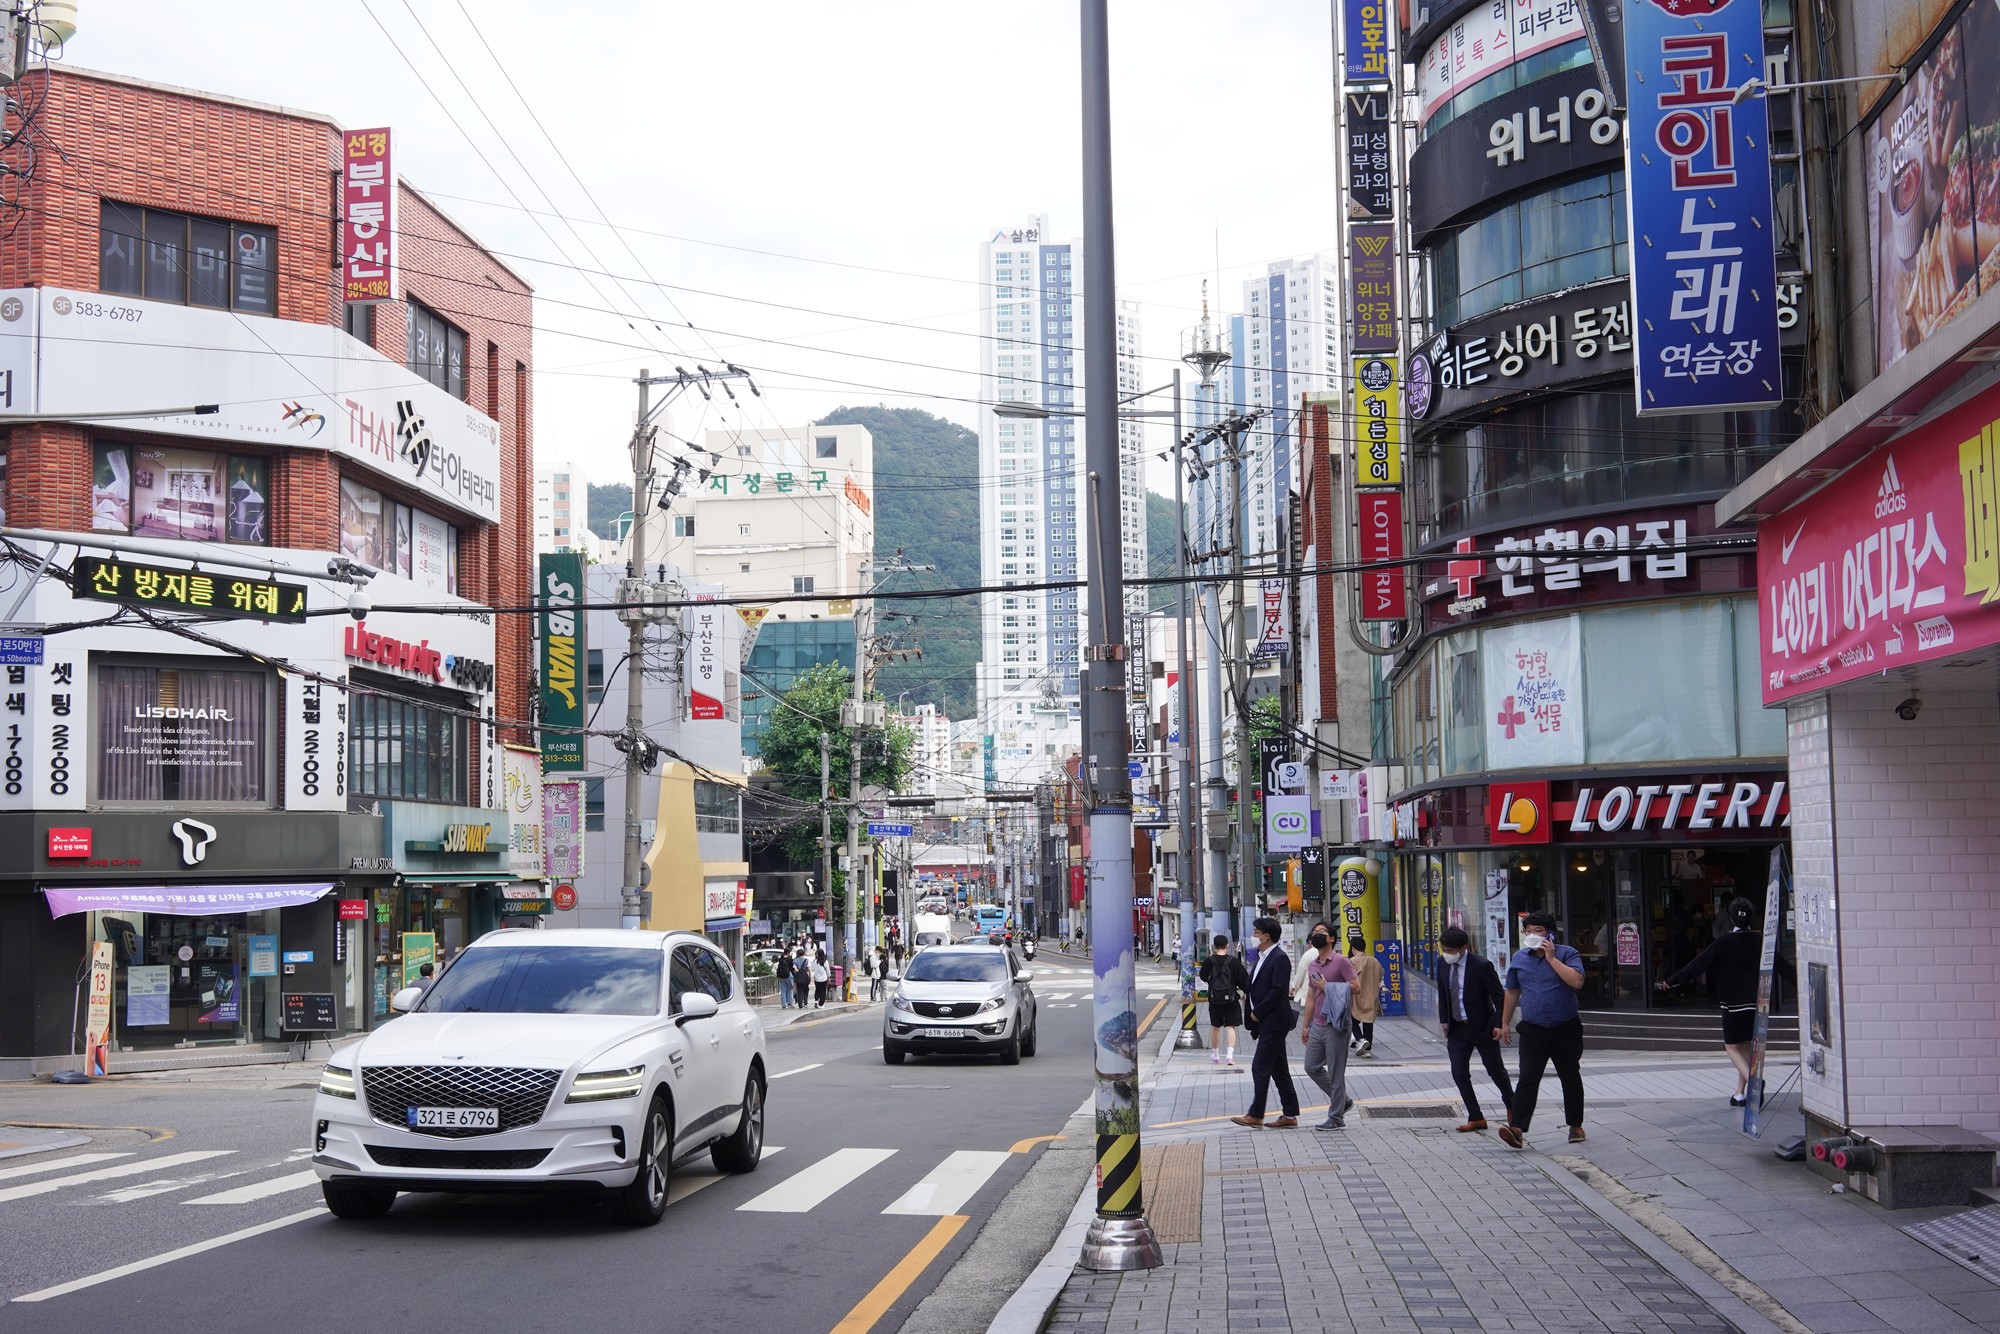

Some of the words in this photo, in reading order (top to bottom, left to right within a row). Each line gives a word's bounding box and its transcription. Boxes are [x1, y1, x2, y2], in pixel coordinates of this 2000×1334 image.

[1519, 2, 1579, 36] 피부관
[1361, 0, 1387, 74] 인후과
[1456, 29, 1508, 73] 보톡스
[1348, 64, 1362, 72] 의원
[1656, 33, 1738, 190] 코인
[348, 133, 386, 157] 선경
[1352, 134, 1371, 190] 피부과
[1370, 132, 1391, 209] 성형외과
[348, 161, 388, 278] 부동산
[1011, 229, 1038, 243] 삼한
[238, 233, 267, 304] 월드
[1666, 198, 1743, 335] 노래
[347, 280, 389, 298] 581-1362
[1357, 282, 1391, 297] 위너
[4, 303, 21, 317] 3F
[55, 300, 70, 311] 3F
[76, 301, 143, 322] 583-6787
[1357, 303, 1391, 321] 양궁
[1358, 324, 1392, 338] 카페
[1430, 328, 1448, 366] NEW
[1440, 316, 1560, 389] 히든싱어
[1571, 301, 1632, 359] 동전
[1660, 340, 1761, 377] 연습장
[1363, 396, 1376, 407] NEW
[176, 417, 230, 430] THERAPY
[240, 424, 278, 434] SHARP
[346, 398, 394, 463] THAI
[466, 414, 490, 438] 583-6787
[1369, 401, 1388, 481] 히든싱어
[431, 443, 494, 512] 타이테라피
[710, 471, 828, 495] 지성문구
[1875, 492, 1907, 520] adidas
[1494, 519, 1687, 597] 헌혈의집
[1842, 512, 1947, 632] 아디다스
[92, 563, 121, 595] 산
[135, 568, 214, 607] 방지를
[228, 581, 279, 614] 위해
[1265, 592, 1284, 640] 부동산
[1771, 561, 1828, 658] 나이키
[547, 572, 578, 709] SUBWAY
[1920, 617, 1951, 646] Supreme
[0, 640, 42, 653] 로50번길
[699, 614, 713, 680] 부산은행
[1838, 647, 1866, 668] Reebok
[7, 654, 42, 664] 50beon-gil
[1515, 648, 1552, 680] 헌혈,
[51, 663, 72, 716] 셋팅
[1517, 675, 1559, 699] 세상에서
[1769, 669, 1785, 691] FILA
[135, 704, 235, 722] LISOHAIR
[1518, 694, 1536, 713] 가장
[124, 725, 141, 733] Based
[163, 726, 175, 734] idea
[184, 727, 210, 736] elegance,
[1534, 704, 1561, 733] 선물
[141, 737, 178, 747] youthfulness
[192, 738, 226, 746] moderation,
[188, 748, 207, 757] quality
[548, 743, 577, 751] 부산대점
[1262, 741, 1288, 752] hair
[5, 724, 22, 795] 17,000
[51, 724, 69, 795] 22,000
[159, 758, 191, 766] satisfaction
[303, 730, 320, 796] 22,000
[545, 754, 580, 763] 513-3331
[1323, 786, 1348, 794] 헌혈의집
[1570, 780, 1790, 833] LOTTERI
[1278, 817, 1300, 828] CU
[444, 822, 491, 853] SUBWAY
[552, 804, 571, 872] 노래연습장
[353, 857, 377, 869] PREMIUM
[378, 857, 395, 869] STORE
[167, 895, 187, 903] 기본!
[189, 894, 206, 903] 요즘
[208, 894, 217, 903] 잘
[219, 893, 245, 902] 나가는
[246, 892, 263, 901] 구독
[266, 891, 282, 899] 모두
[502, 901, 546, 912] SUBWAY
[94, 960, 110, 970] iPhone
[1388, 942, 1402, 1001] 수이비인후과
[95, 973, 106, 992] 13
[459, 1111, 495, 1126] 6796
